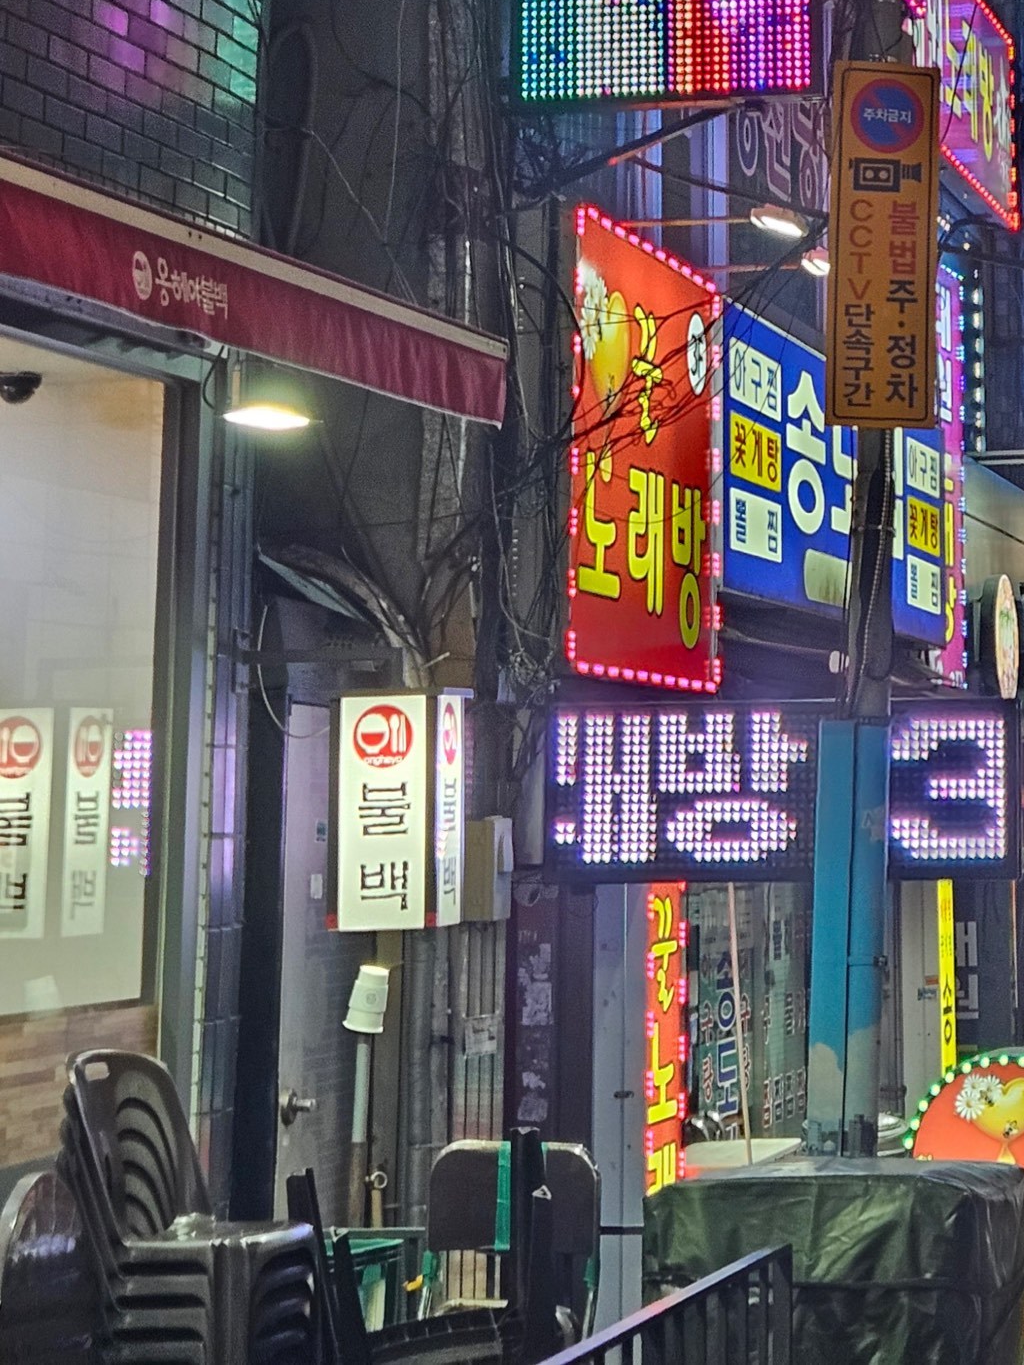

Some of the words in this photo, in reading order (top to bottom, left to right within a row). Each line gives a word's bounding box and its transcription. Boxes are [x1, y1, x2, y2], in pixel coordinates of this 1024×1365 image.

[862, 107, 912, 125] 주차금지
[733, 348, 780, 413] 아구찜
[732, 420, 781, 488] 꽃게탕
[907, 438, 941, 496] 아구찜
[578, 448, 706, 651] 노래방
[908, 503, 942, 552] 꽃게탕
